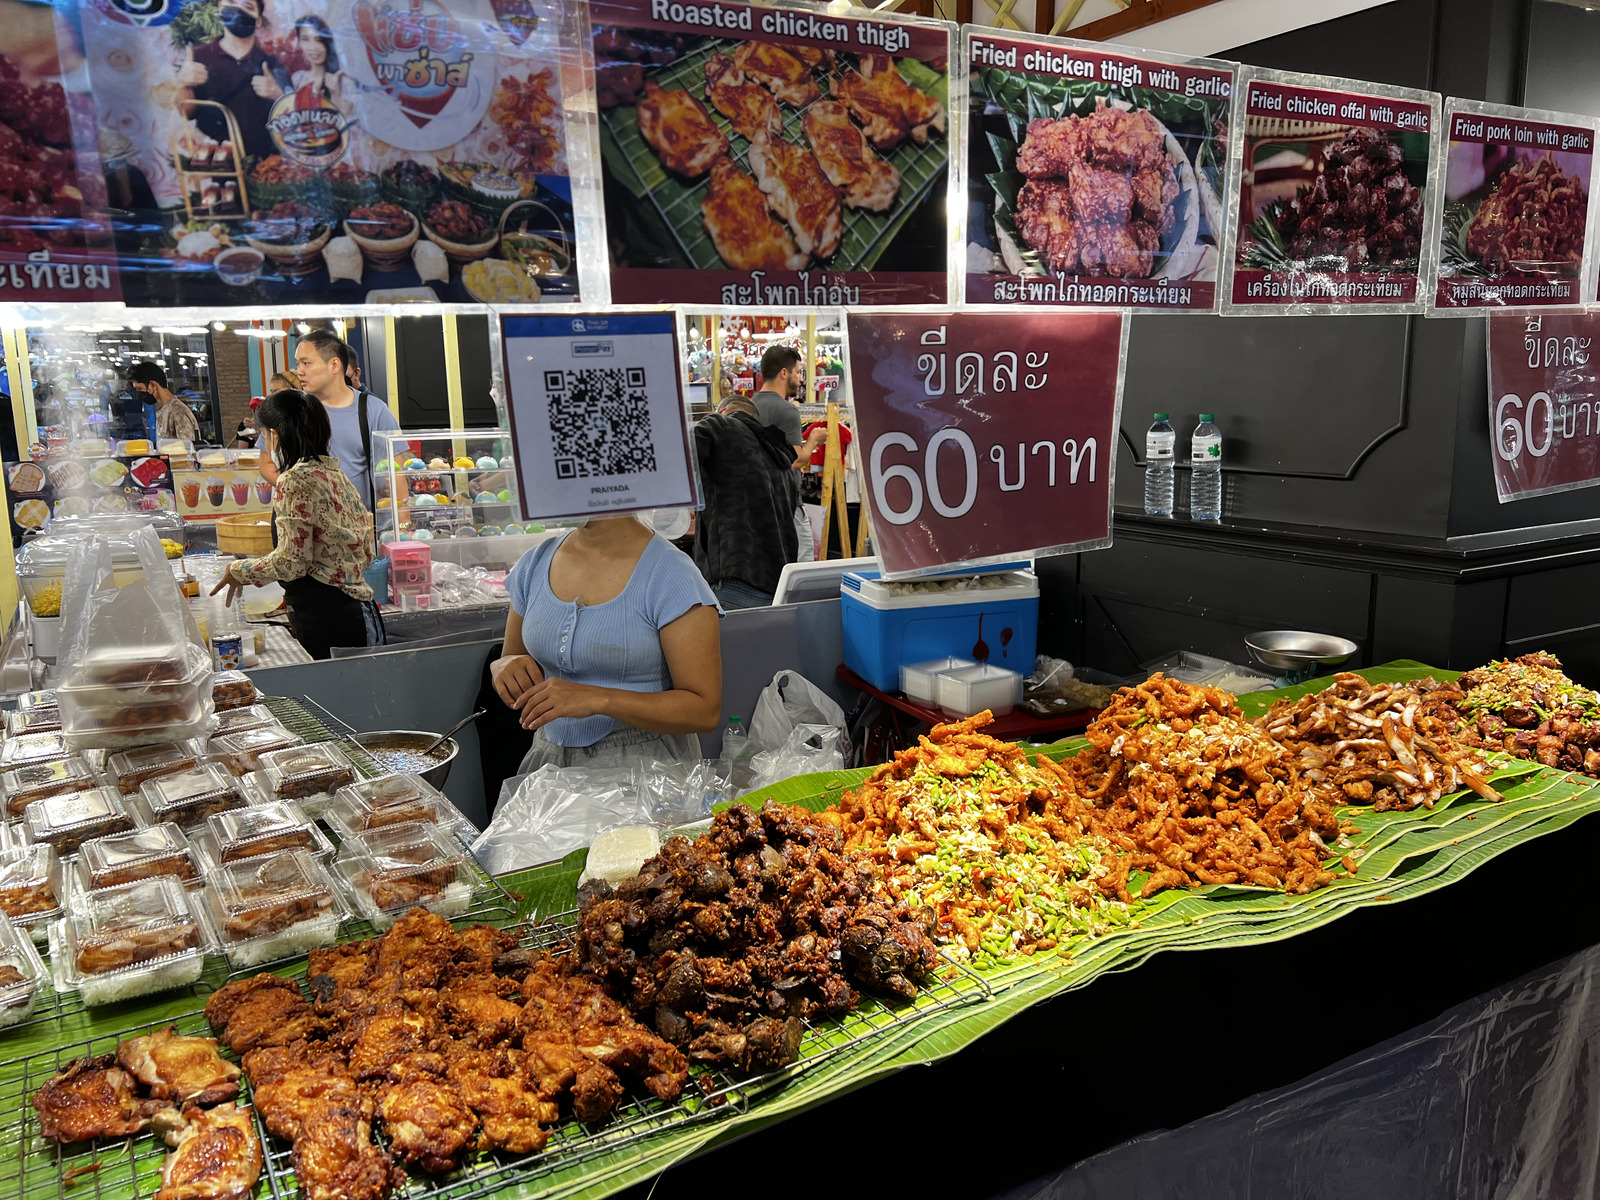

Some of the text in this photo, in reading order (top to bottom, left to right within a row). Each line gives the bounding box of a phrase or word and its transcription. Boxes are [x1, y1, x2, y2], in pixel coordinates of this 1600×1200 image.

[652, 0, 910, 52] Roasted chicken thigh
[971, 41, 1231, 97] Fried chicken thigh with garlic
[1250, 90, 1428, 127] Fried chicken offal with garlic
[1455, 118, 1589, 150] Fried pork loin with garlic
[0, 249, 111, 289] เทียม
[721, 271, 860, 305] สะโพกไก่อบ
[993, 271, 1191, 304] สะโพกไก่ทอดกระเทียม
[1247, 263, 1402, 297] เครื่องในไกทอดกระเทียม
[917, 325, 1049, 396] ขีดละ
[1525, 315, 1592, 368] ขีดละ
[1495, 392, 1554, 461] 60
[590, 484, 630, 494] PRAIYADA
[869, 428, 1097, 525] 60 บาท
